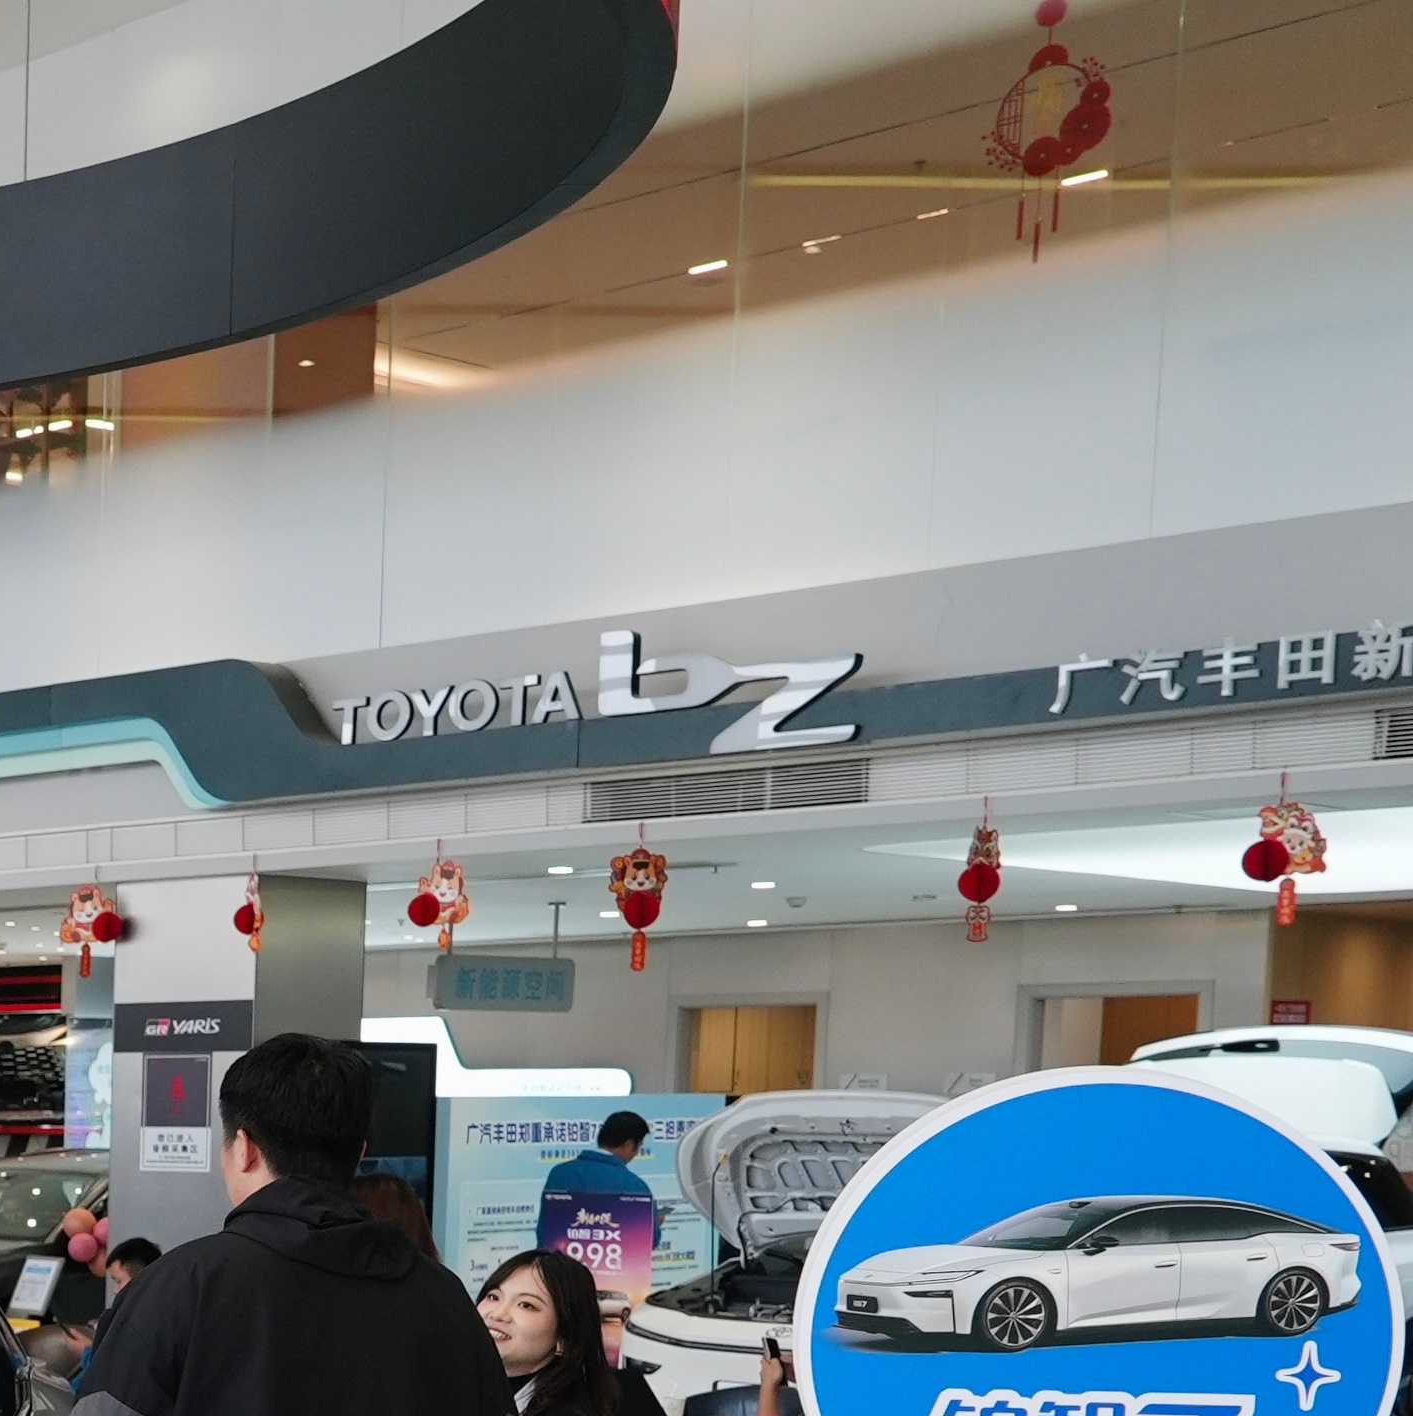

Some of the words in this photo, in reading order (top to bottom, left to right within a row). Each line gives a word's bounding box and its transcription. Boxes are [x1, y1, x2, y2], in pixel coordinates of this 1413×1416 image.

[1048, 619, 1413, 715] 广汽丰田新
[331, 669, 581, 746] TOYOTA
[172, 1018, 221, 1035] YARIS
